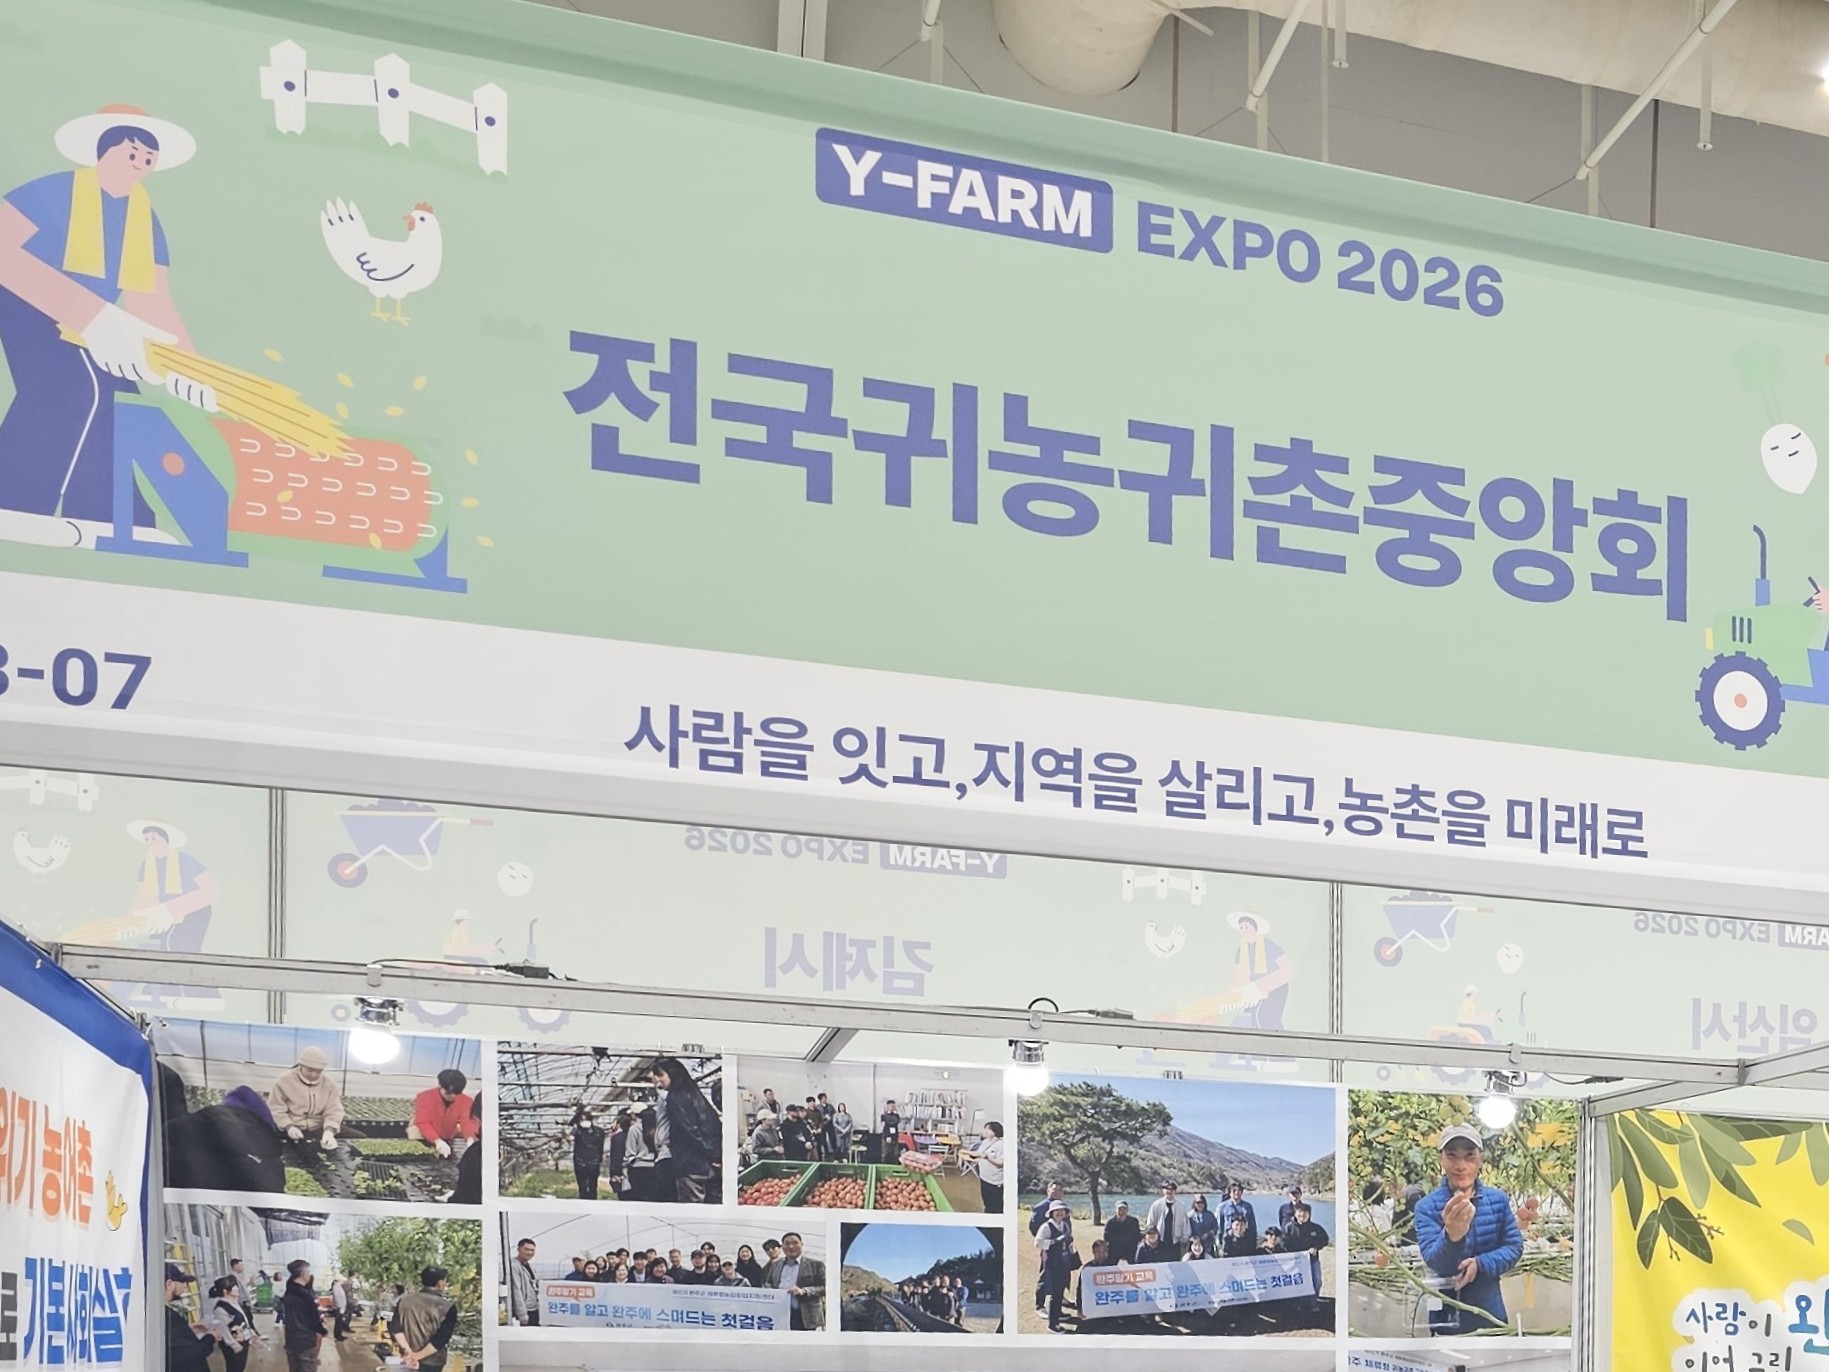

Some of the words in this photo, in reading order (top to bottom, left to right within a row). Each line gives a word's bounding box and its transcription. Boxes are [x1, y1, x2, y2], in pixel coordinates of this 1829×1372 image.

[832, 142, 1092, 239] Y-FARM
[1137, 201, 1322, 285] EXPO
[1337, 240, 1505, 317] 2026
[563, 330, 1687, 621] 전국귀농귀촌중앙회
[0, 645, 152, 708] -07
[624, 702, 815, 781] 사람을
[1505, 799, 1649, 861] 미래로
[1095, 1289, 1139, 1306] 완주를
[1271, 1272, 1304, 1288] 첫걸음
[548, 1302, 580, 1315] 완주를
[585, 1304, 608, 1317] 알고
[612, 1305, 650, 1320] 완주에
[657, 1308, 716, 1326] 스며드는
[721, 1313, 774, 1330] 첫걸음
[1686, 1302, 1772, 1337] 사람이
[1348, 1356, 1362, 1367] 주
